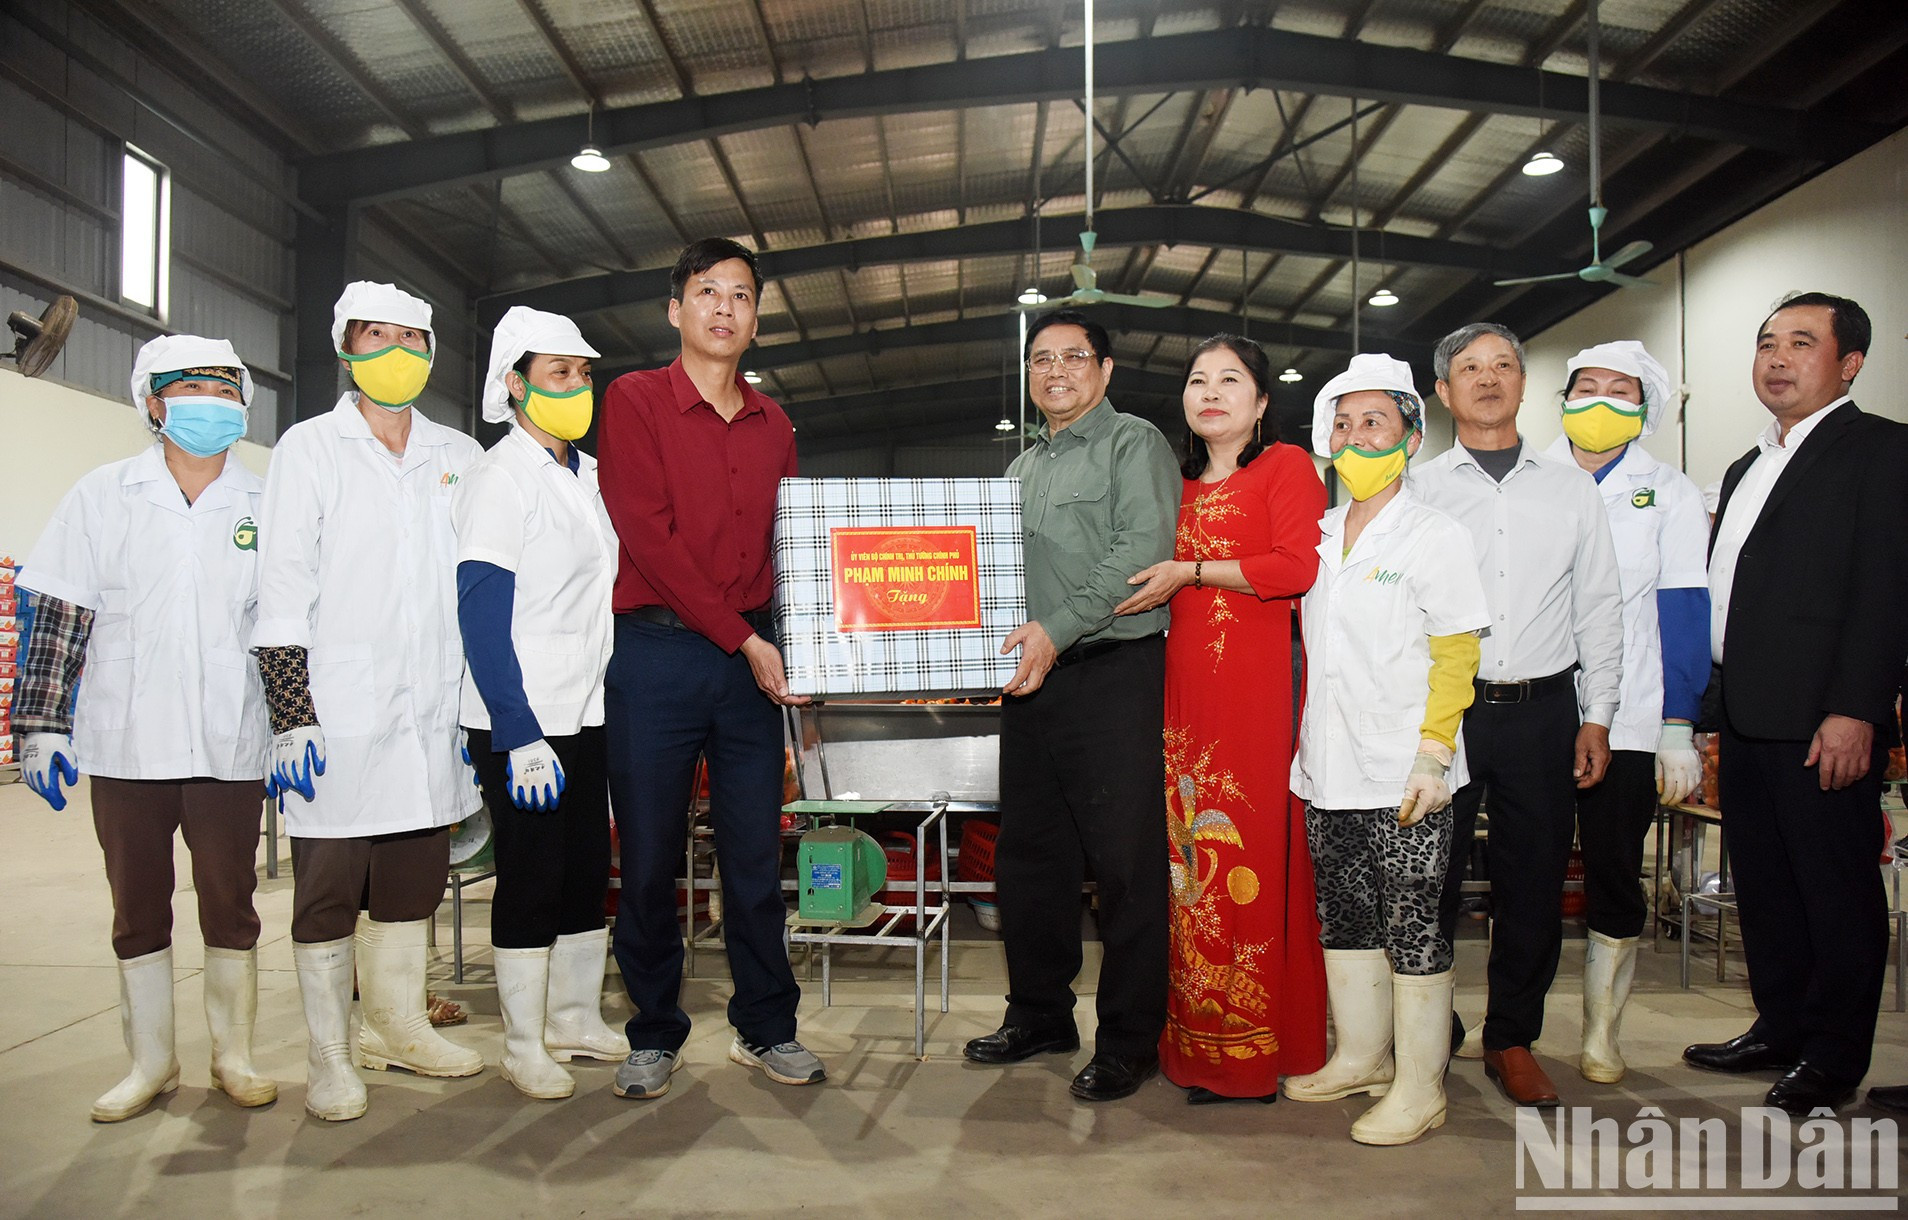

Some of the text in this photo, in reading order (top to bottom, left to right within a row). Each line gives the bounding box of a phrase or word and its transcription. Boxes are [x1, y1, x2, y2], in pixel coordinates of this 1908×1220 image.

[844, 562, 969, 586] PHẠM MINH CHÍNH
[886, 589, 928, 605] Tặng
